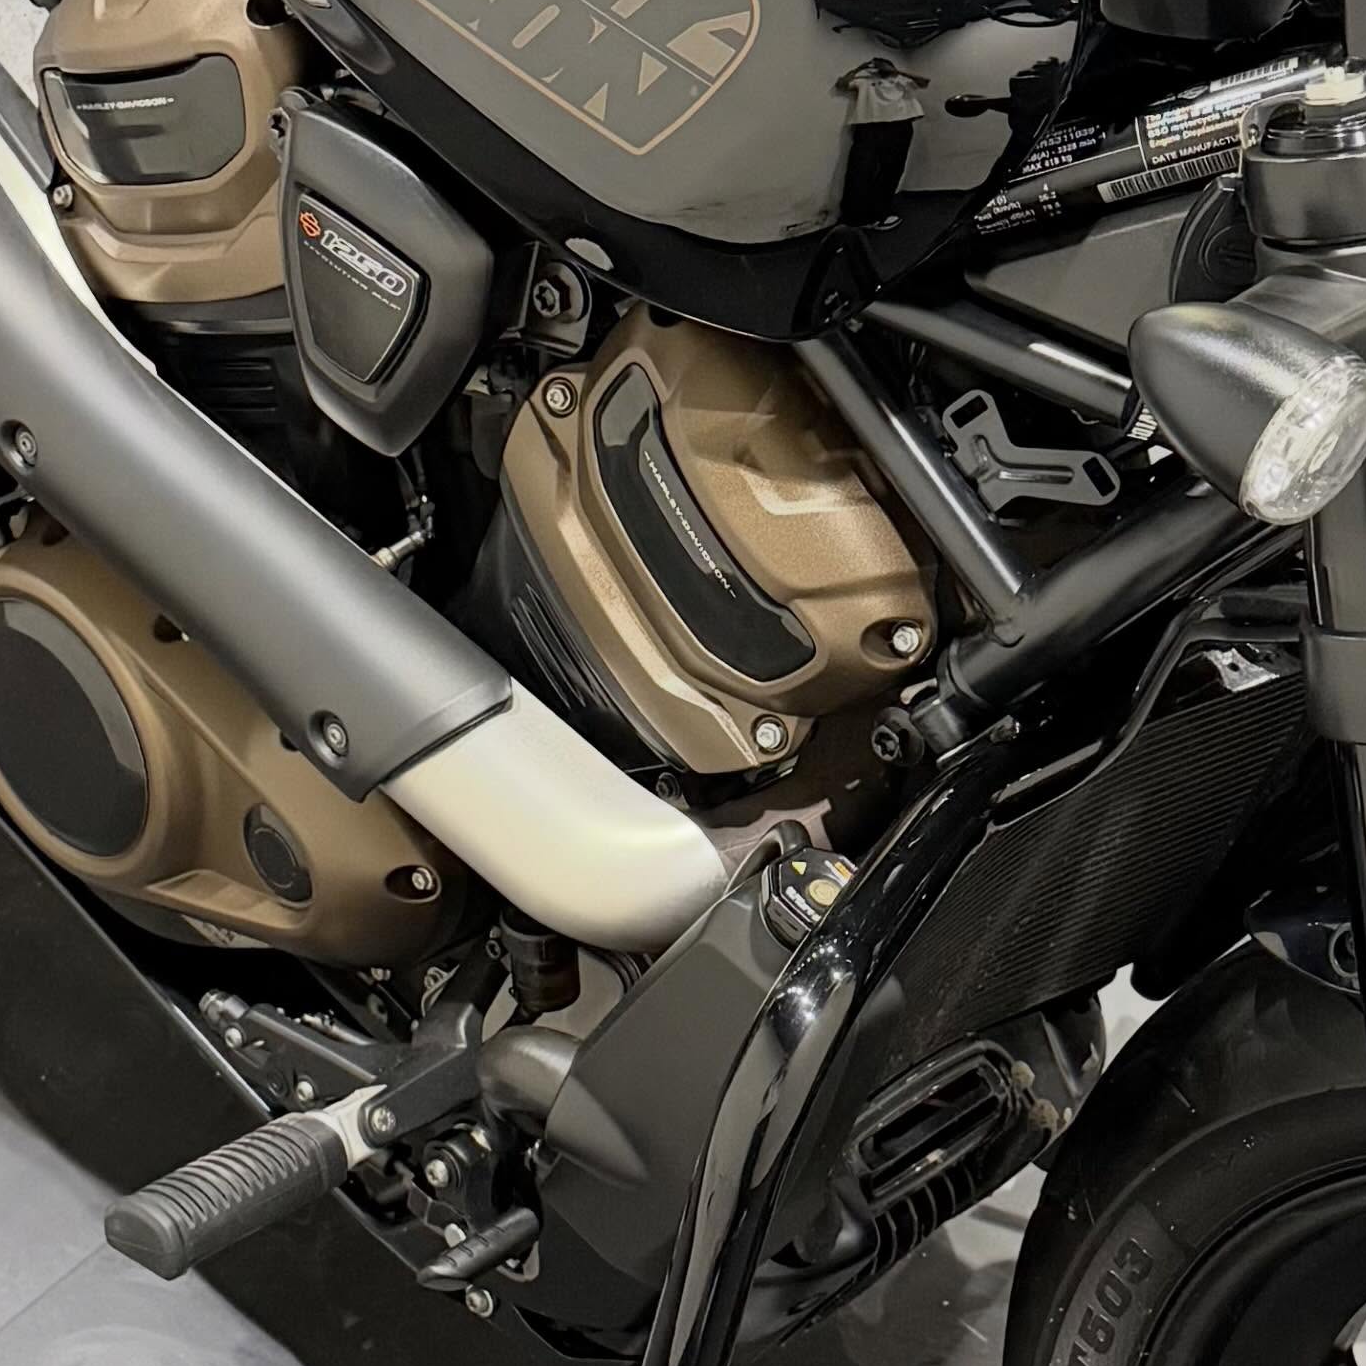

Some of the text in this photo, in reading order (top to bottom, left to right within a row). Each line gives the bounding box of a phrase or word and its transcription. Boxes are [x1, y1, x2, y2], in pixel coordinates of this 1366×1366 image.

[1152, 136, 1241, 165] DATE MANUFACTU
[321, 230, 406, 296] 1250
[648, 460, 731, 590] HARLEY-DAVIDSON
